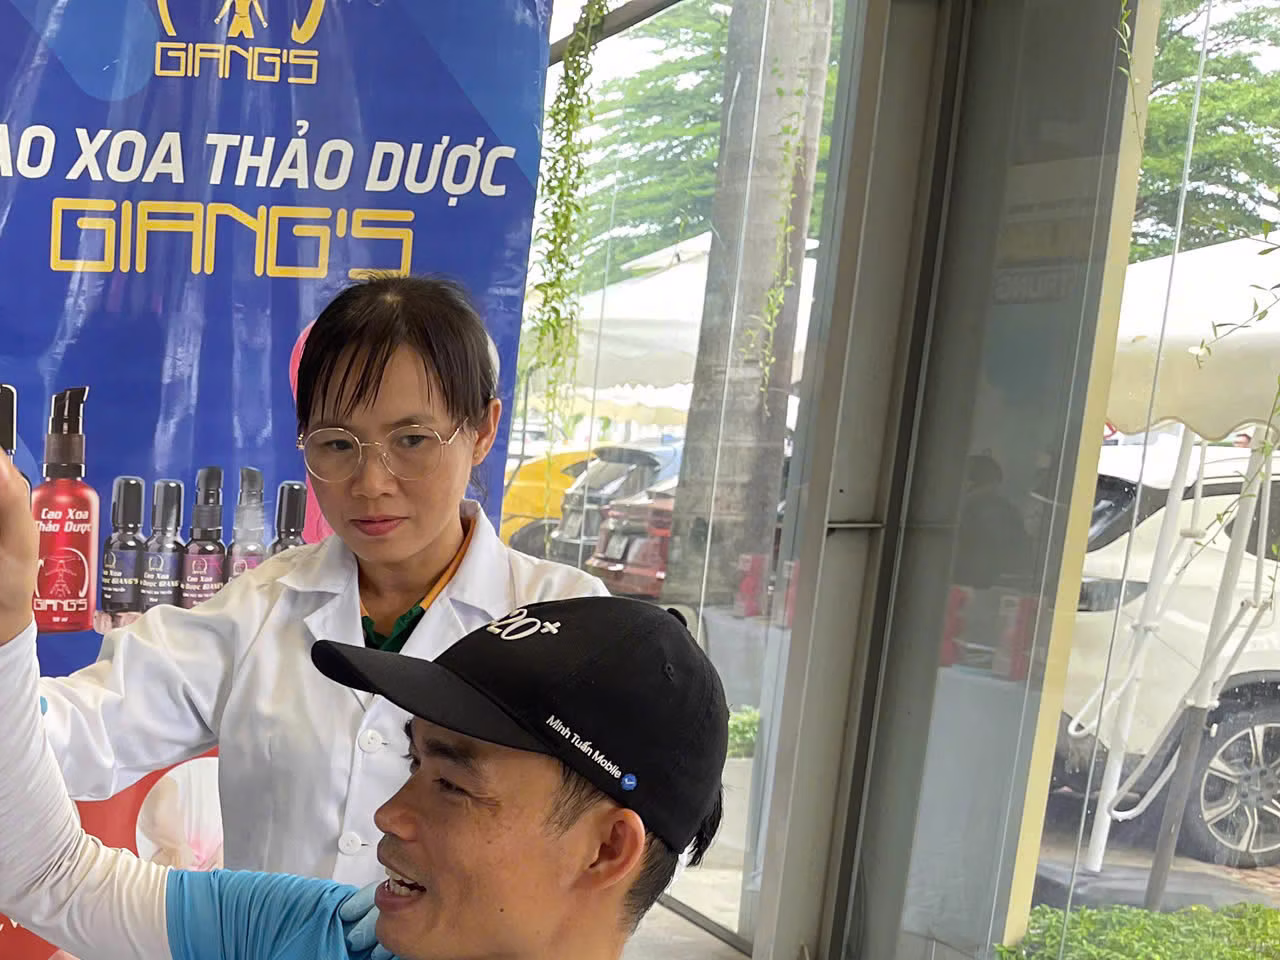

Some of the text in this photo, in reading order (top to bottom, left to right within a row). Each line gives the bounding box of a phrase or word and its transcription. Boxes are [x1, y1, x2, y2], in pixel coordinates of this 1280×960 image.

[154, 41, 319, 84] GIANG'S
[65, 126, 185, 184] XOA
[204, 121, 354, 191] THẢO
[364, 135, 516, 206] DƯỢC
[50, 198, 415, 279] GIANG'S
[41, 508, 88, 520] Cao Xoa
[546, 715, 621, 779] Minh Tuấn Mobile
